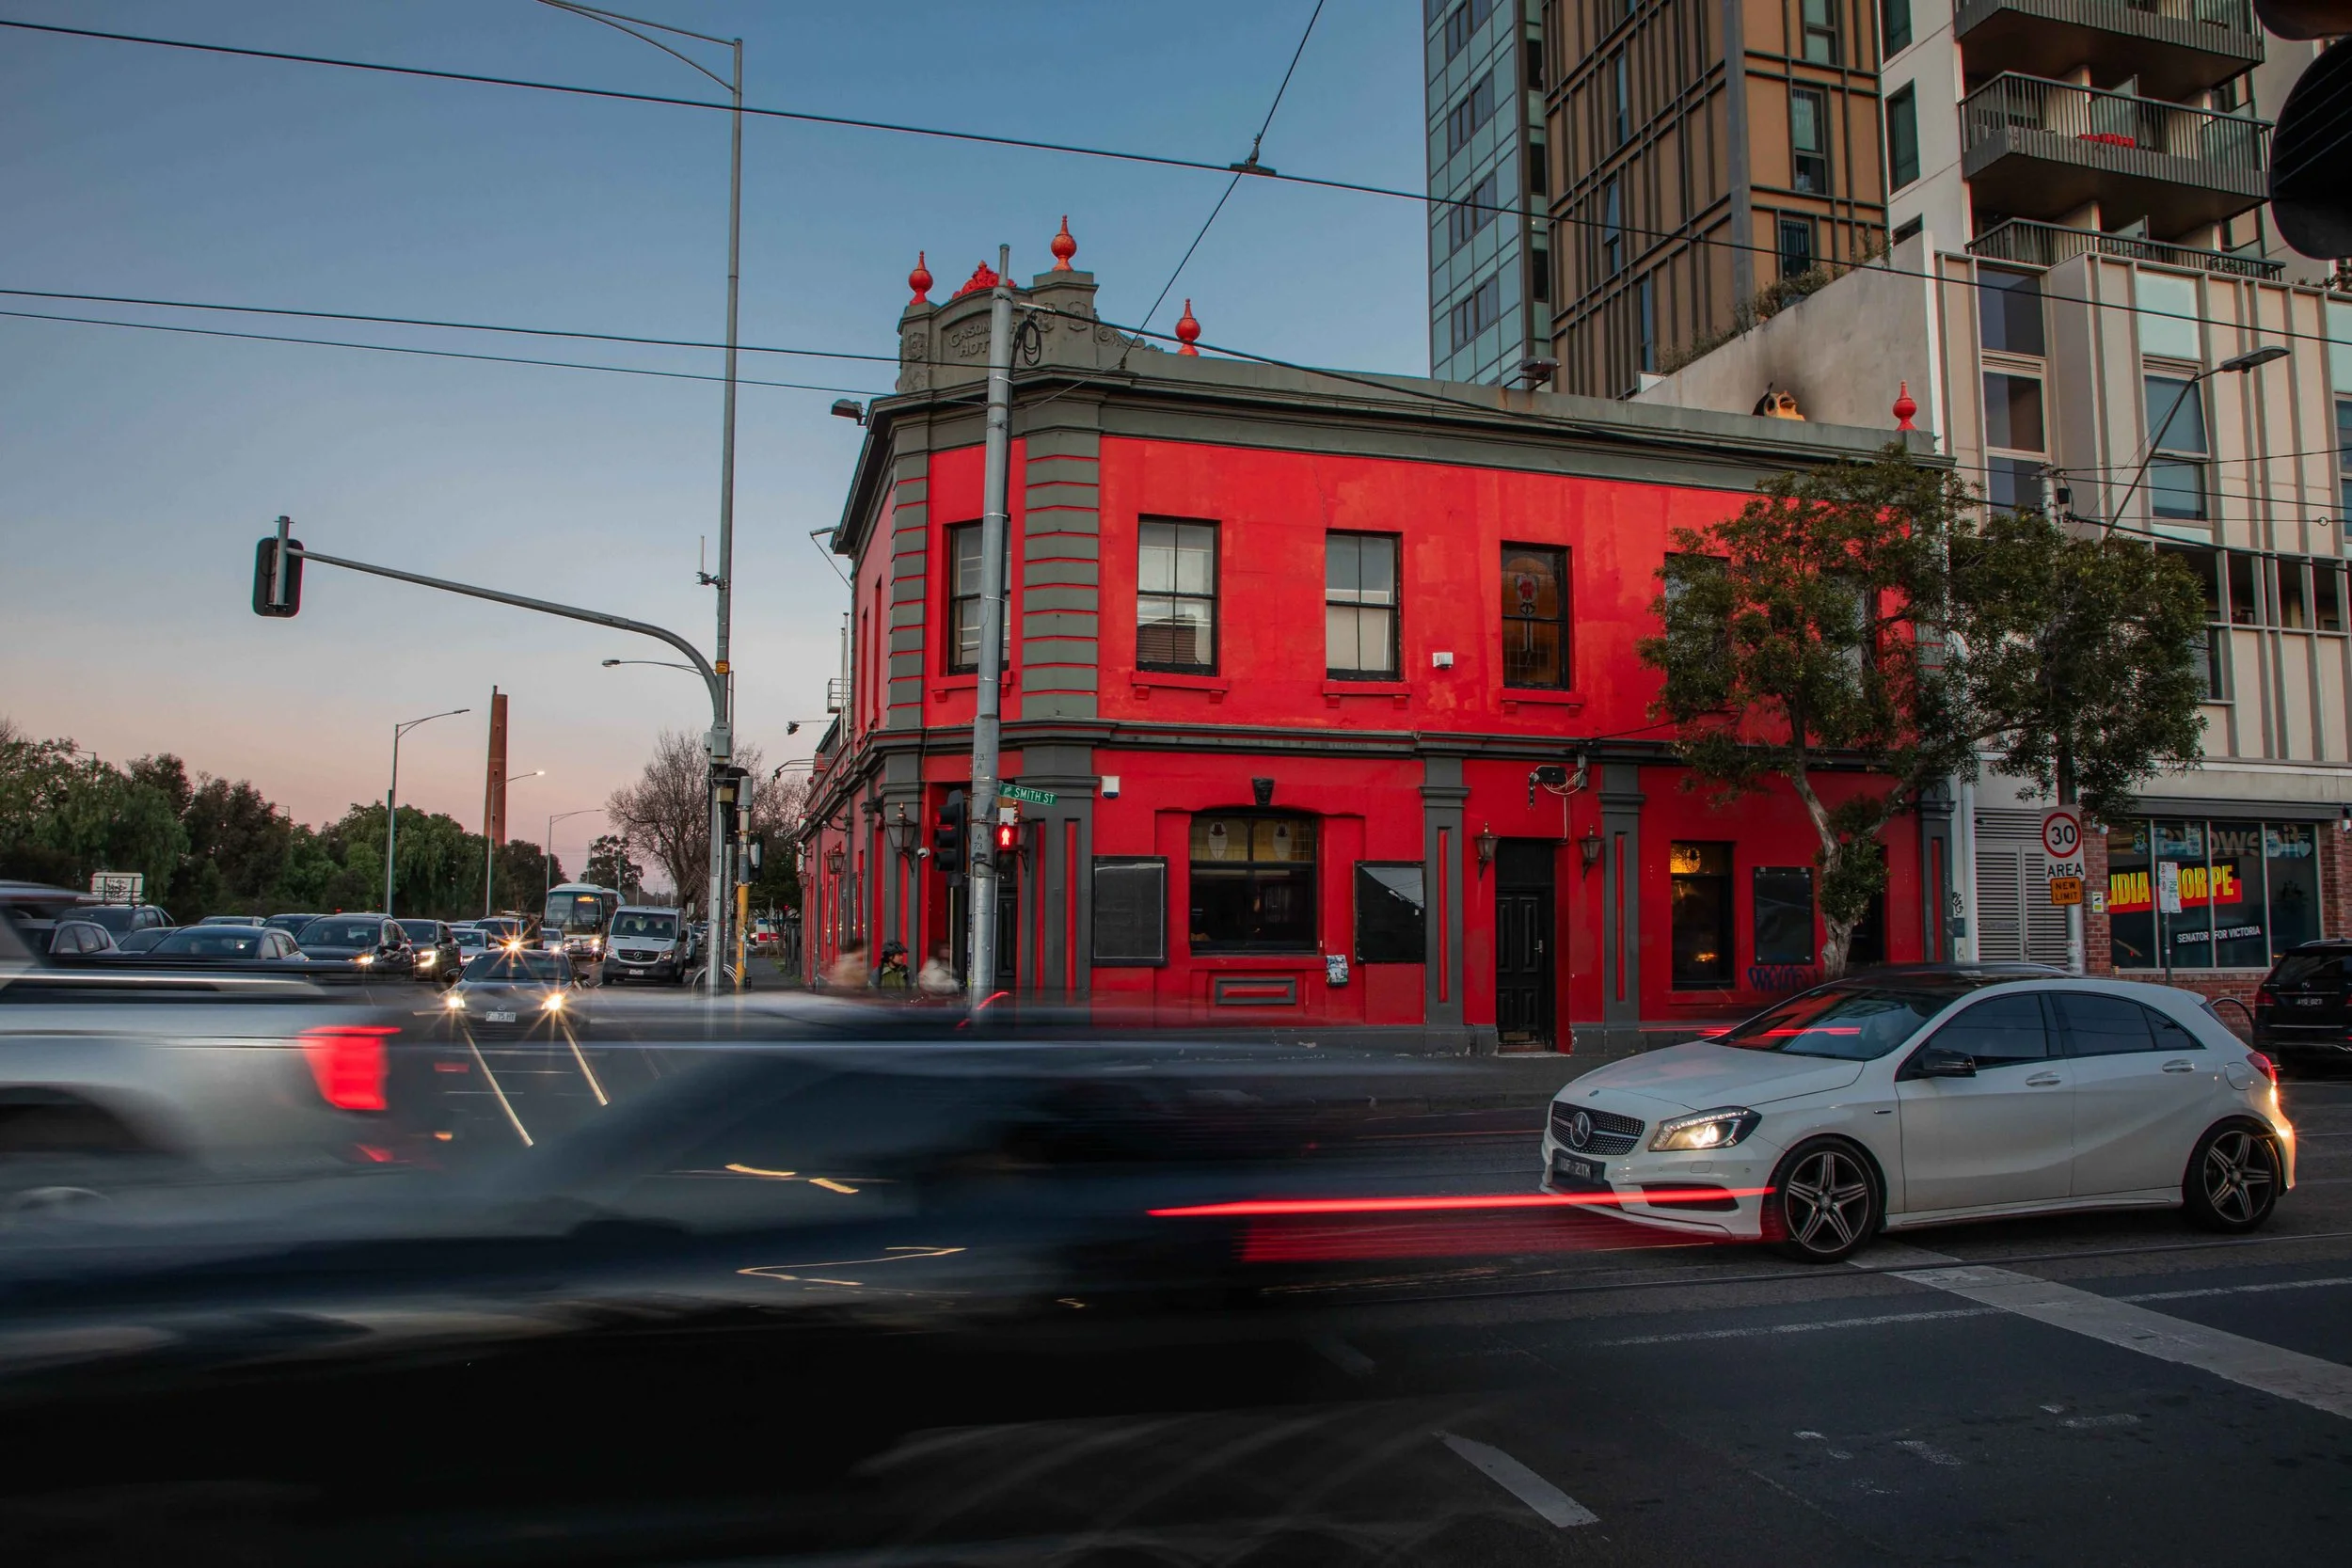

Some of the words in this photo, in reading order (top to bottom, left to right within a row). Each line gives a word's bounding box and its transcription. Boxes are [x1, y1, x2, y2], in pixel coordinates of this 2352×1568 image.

[1014, 787, 1041, 802] SMITH
[1043, 793, 1055, 804] ST
[2051, 825, 2075, 846] 30
[2047, 863, 2084, 878] AREA
[2055, 880, 2075, 890] NEW
[2108, 872, 2151, 906] IDIA
[2177, 864, 2234, 899] ORPE
[2055, 892, 2077, 901] LIMIT
[2176, 931, 2209, 943] SENATOR
[2214, 929, 2228, 940] FOR
[2228, 925, 2261, 938] VICTORIA
